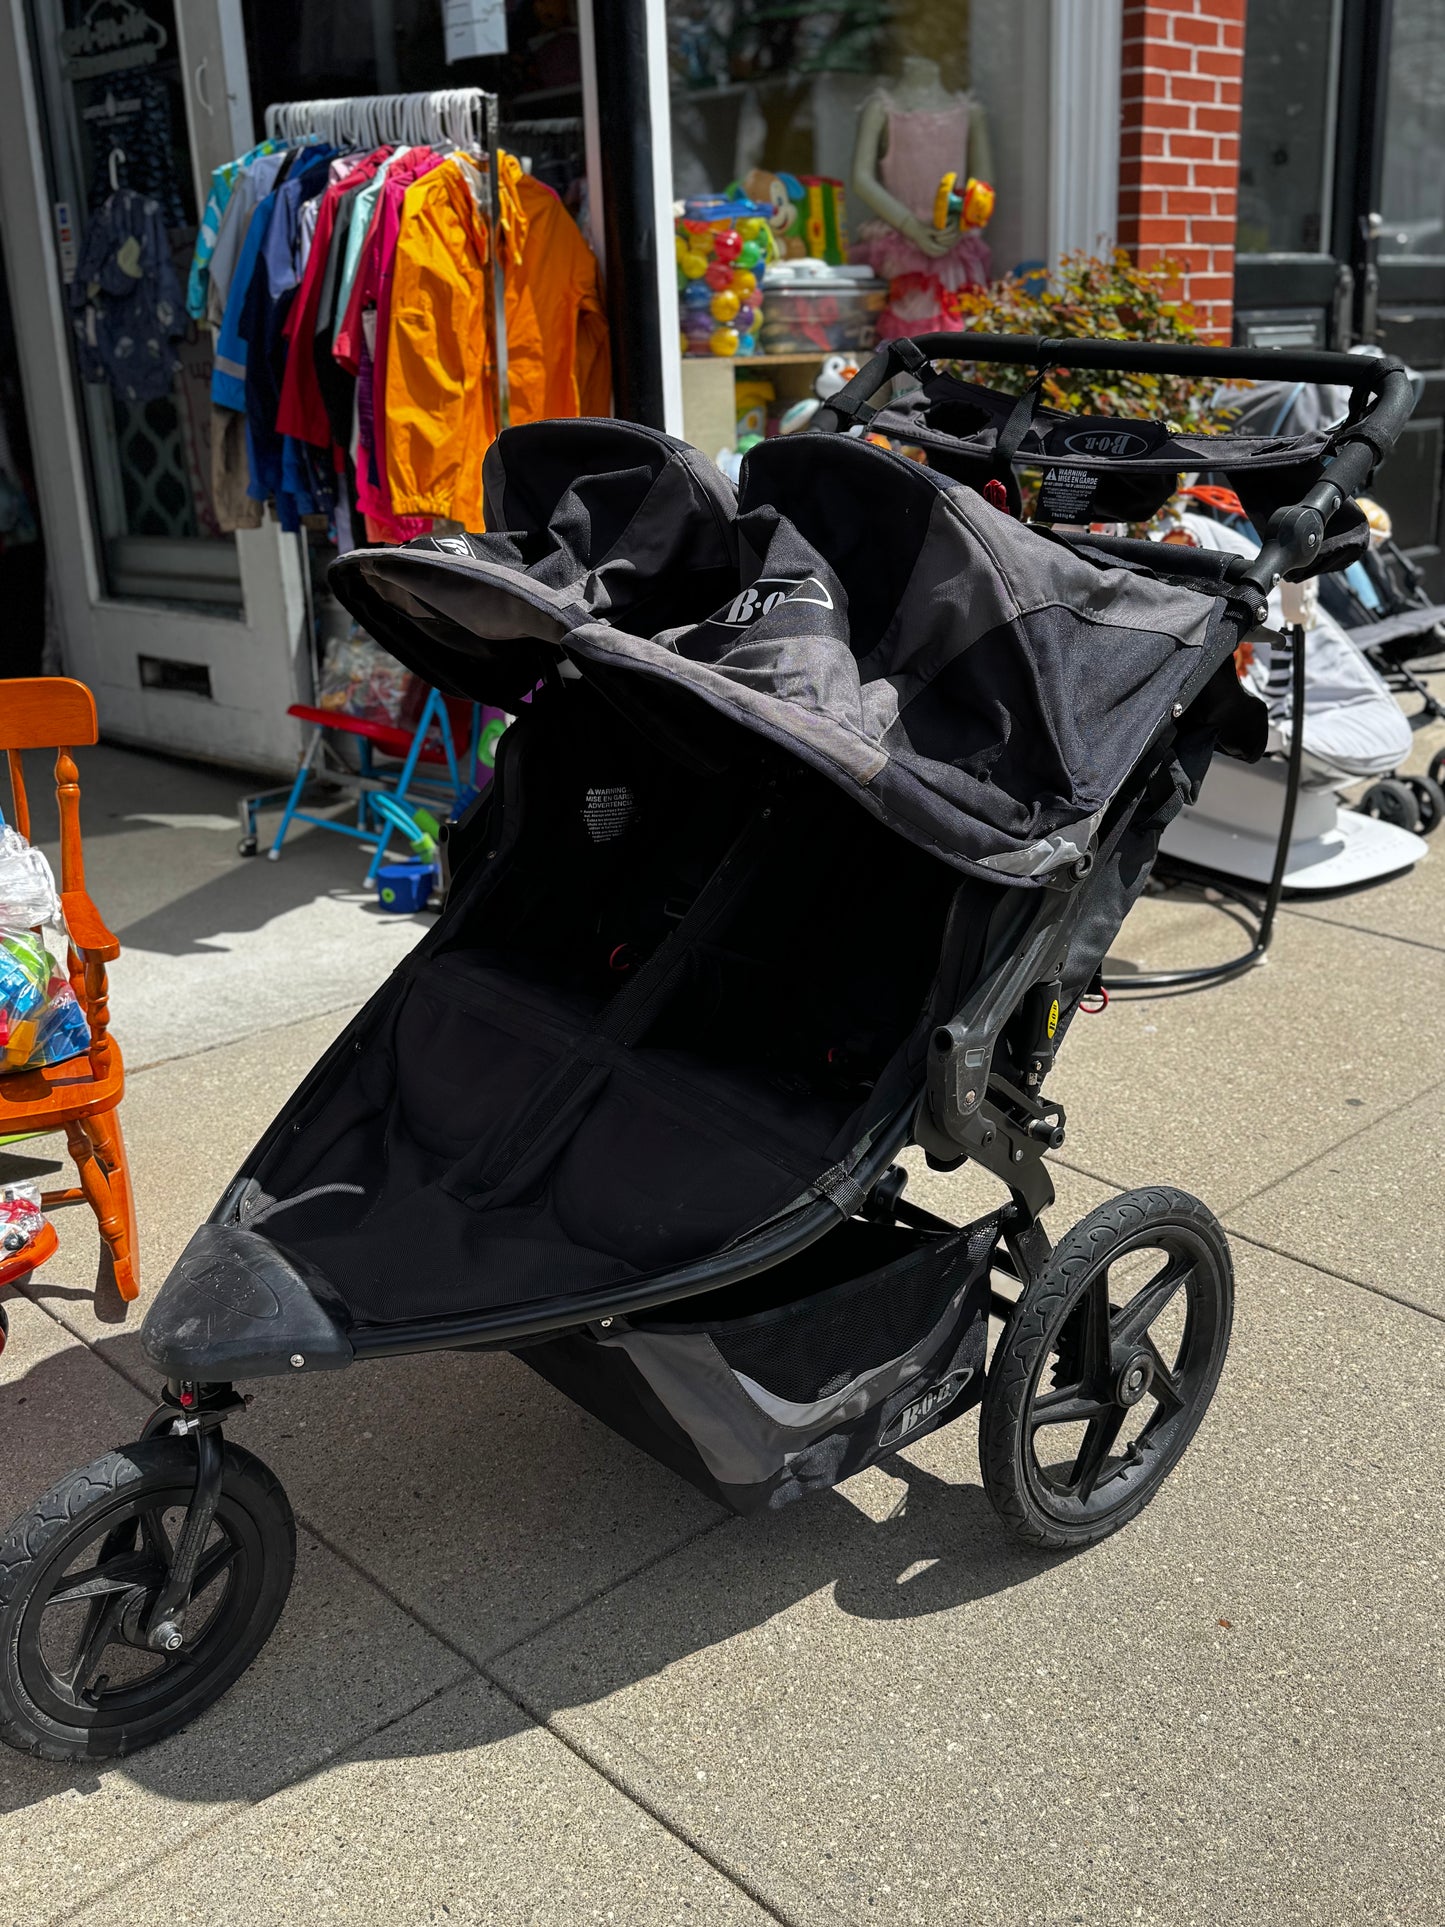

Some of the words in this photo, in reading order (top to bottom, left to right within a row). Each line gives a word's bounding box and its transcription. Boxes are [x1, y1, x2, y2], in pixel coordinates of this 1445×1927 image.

[1058, 468, 1088, 477] WARNING
[1057, 475, 1071, 483] MISE
[1071, 476, 1079, 484] EN
[1079, 477, 1098, 486] GARDE
[595, 786, 627, 796] WARNING
[585, 795, 602, 803] MISE
[613, 793, 633, 801] GAR
